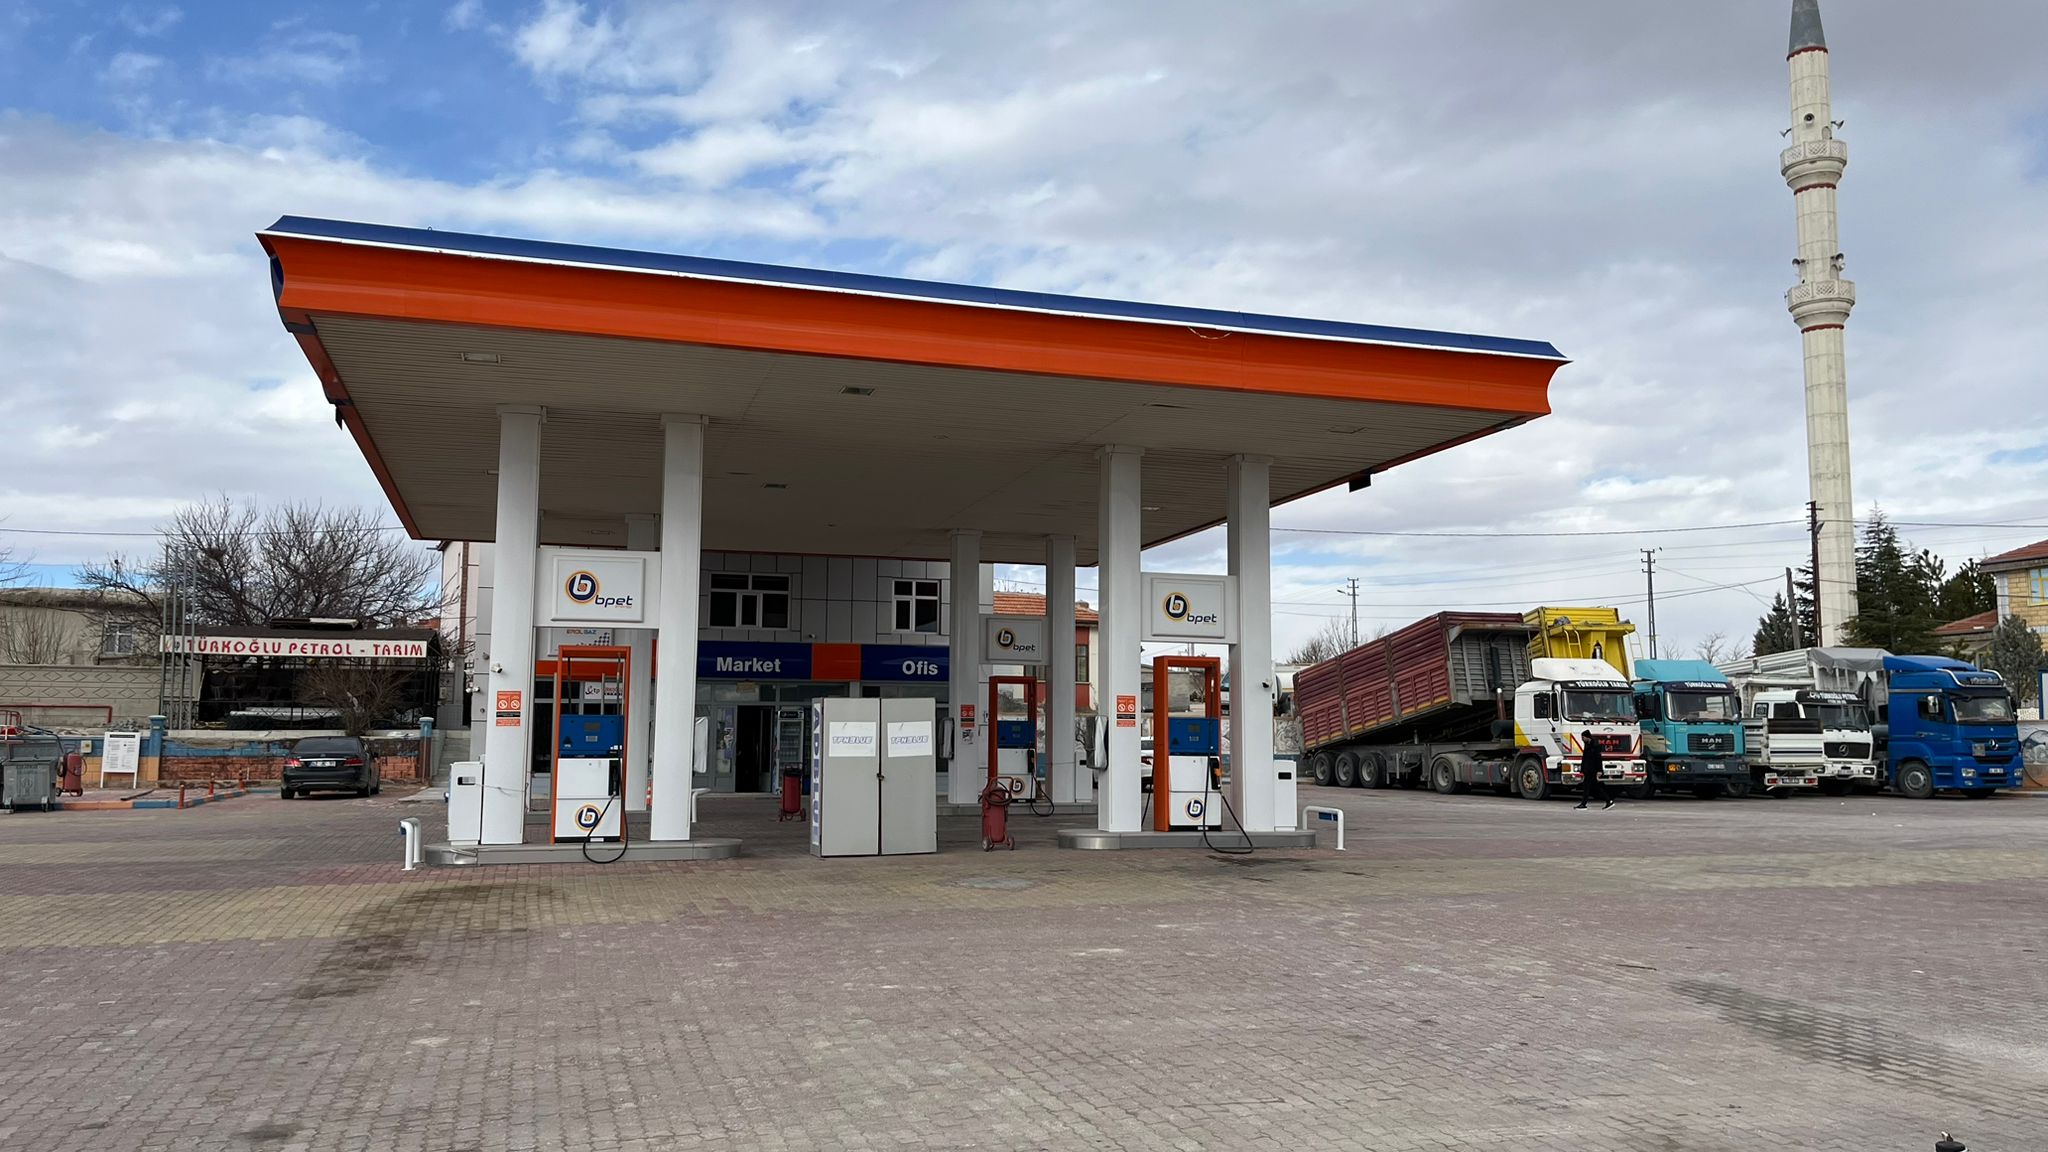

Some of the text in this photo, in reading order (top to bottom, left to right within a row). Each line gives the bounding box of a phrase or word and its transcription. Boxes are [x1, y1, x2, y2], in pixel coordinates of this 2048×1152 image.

[595, 594, 633, 608] bpet
[1187, 612, 1217, 625] bpet
[187, 636, 282, 654] TÜRKOĞLU
[288, 642, 352, 655] PETROL
[373, 643, 423, 656] TARIM
[1013, 643, 1036, 651] bpet
[716, 656, 781, 672] Market
[902, 660, 938, 675] Ofis
